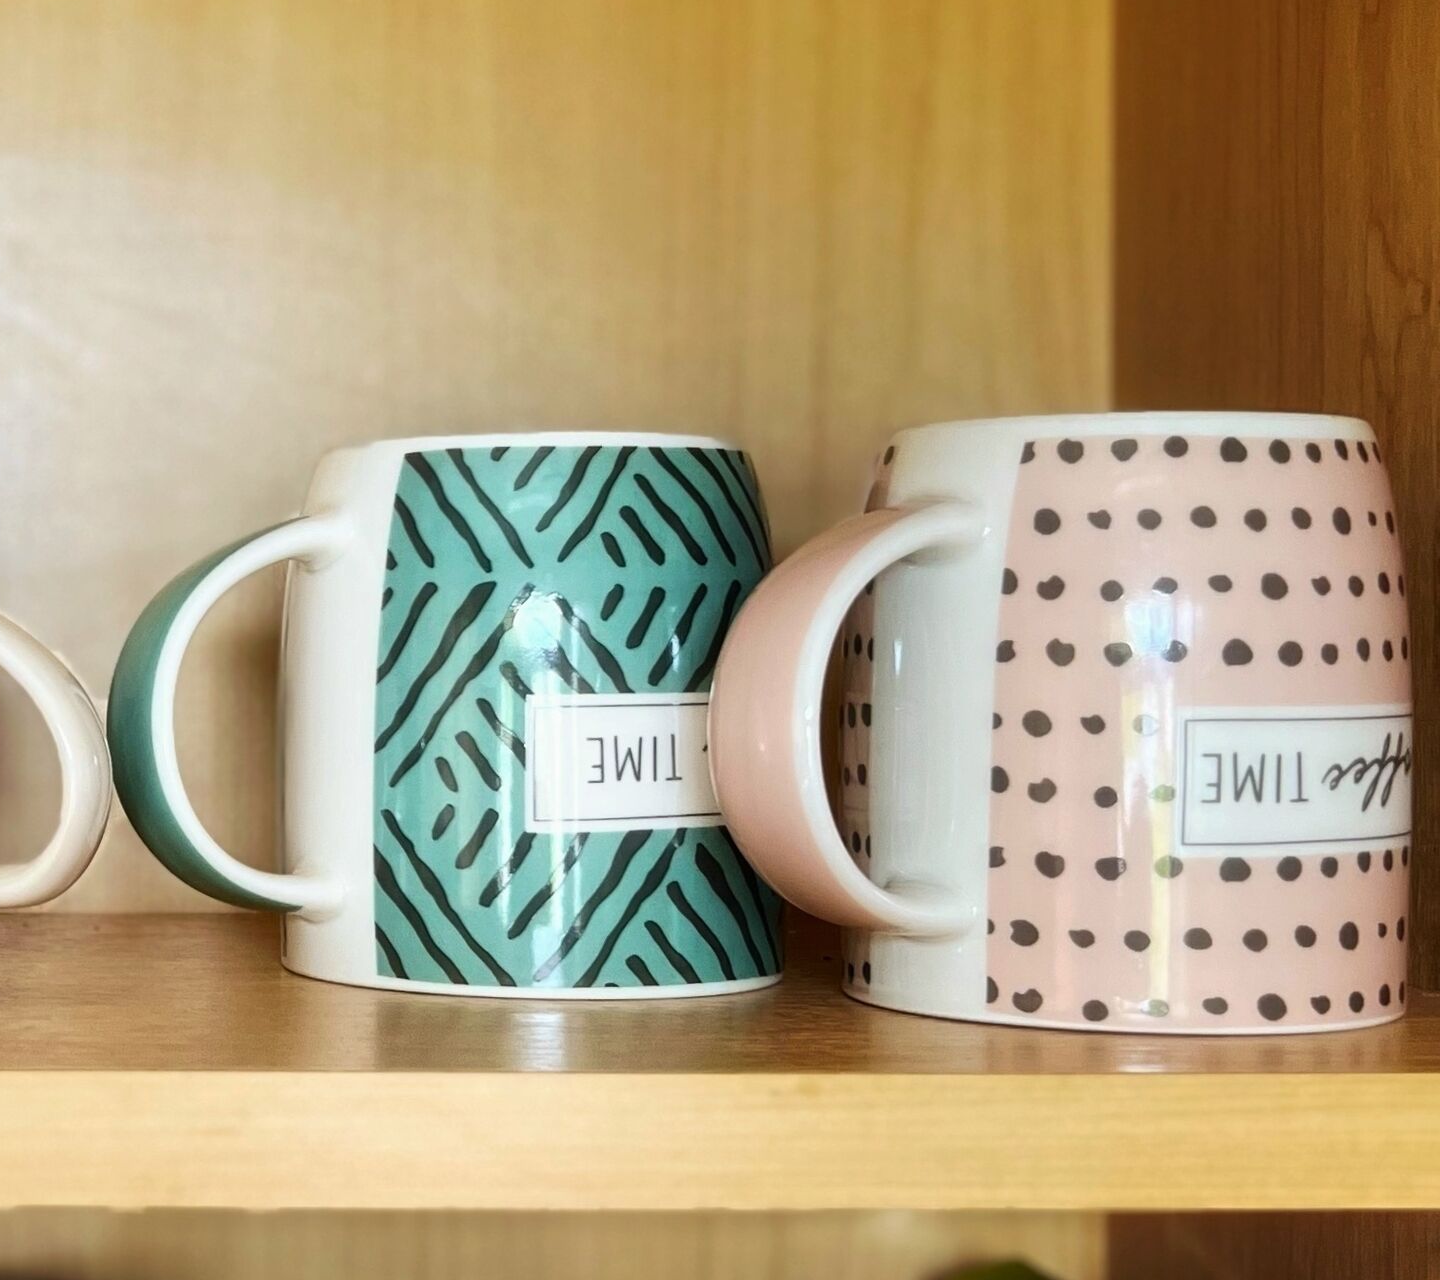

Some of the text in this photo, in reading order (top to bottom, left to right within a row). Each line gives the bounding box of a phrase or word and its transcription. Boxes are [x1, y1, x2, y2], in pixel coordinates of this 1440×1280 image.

[586, 734, 683, 783] TIME
[1201, 732, 1410, 812] offee TIME
